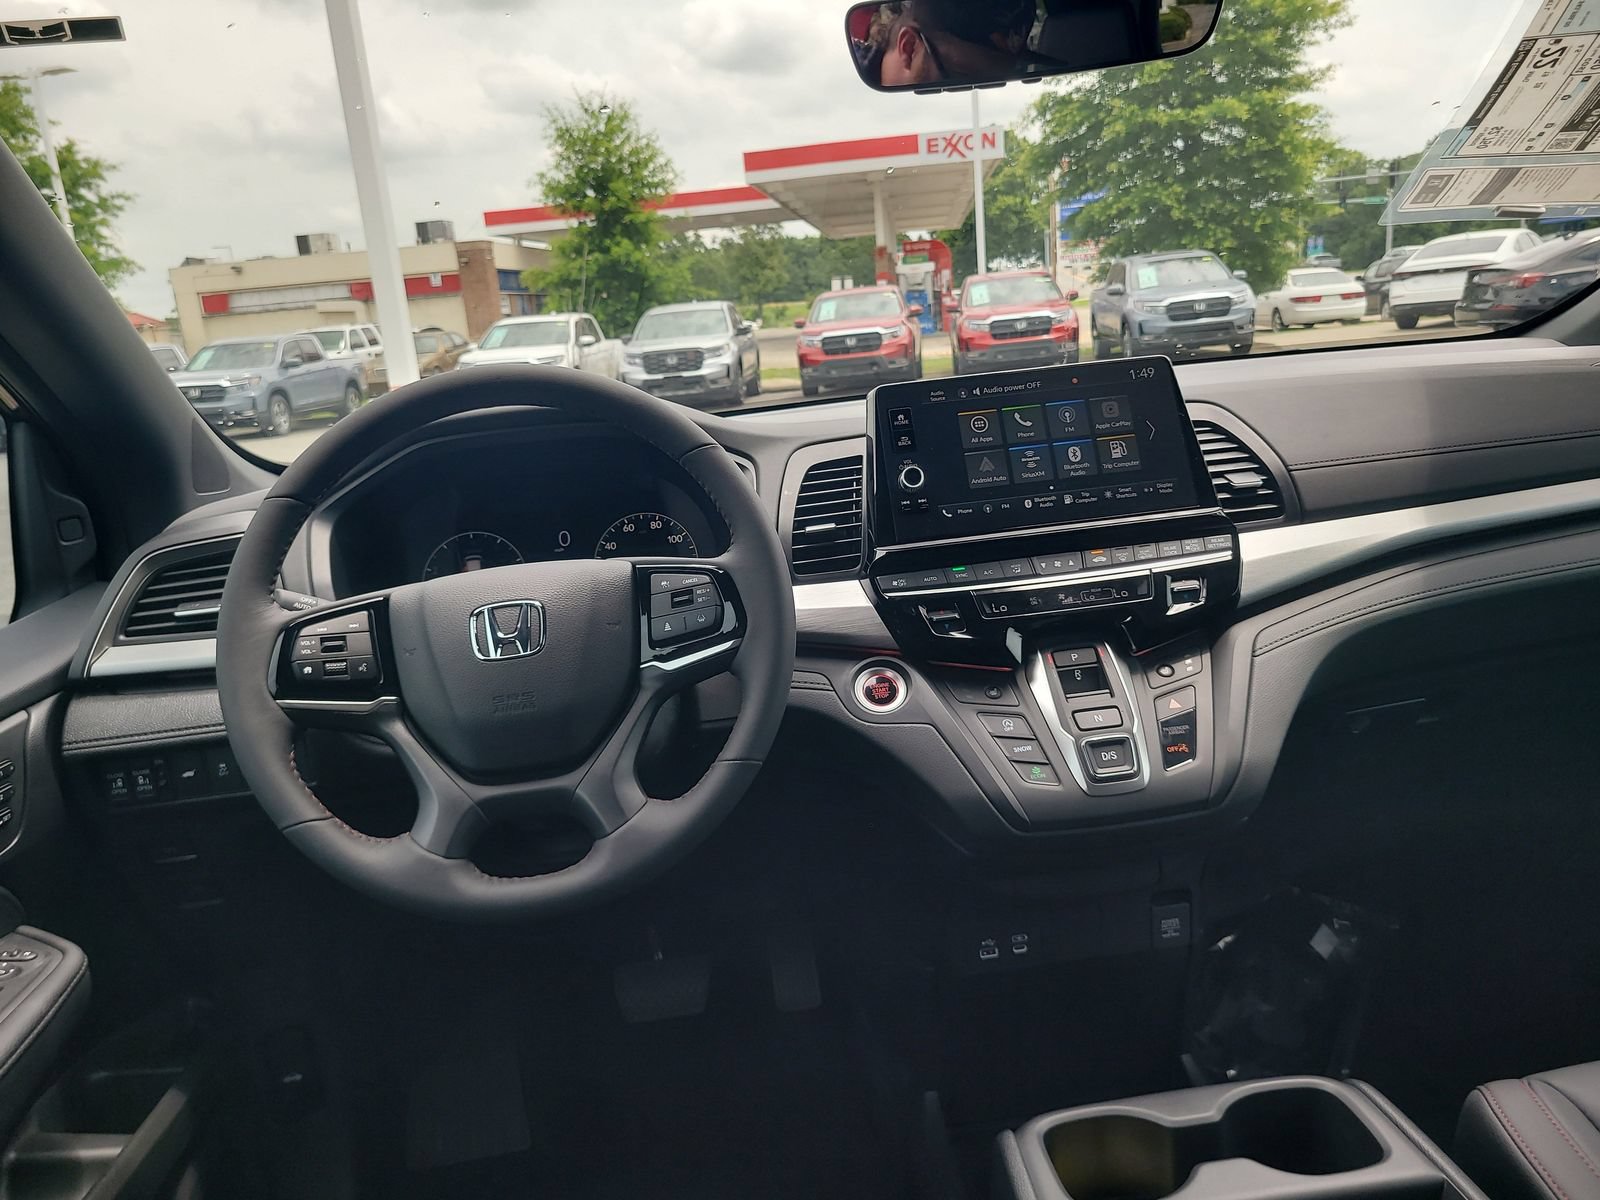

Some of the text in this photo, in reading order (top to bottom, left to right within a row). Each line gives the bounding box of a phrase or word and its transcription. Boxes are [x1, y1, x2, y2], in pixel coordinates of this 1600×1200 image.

[928, 132, 996, 158] EXXON
[1129, 367, 1154, 380] 1:49
[983, 386, 1002, 394] Audio
[1114, 460, 1139, 468] Computer
[623, 523, 635, 532] 60
[650, 520, 662, 529] 80
[558, 530, 570, 547] 0
[667, 534, 683, 544] 100
[604, 542, 617, 550] 40
[1113, 588, 1128, 598] Lo
[992, 603, 1008, 613] Lo
[1075, 670, 1082, 678] R
[1101, 751, 1117, 761] D/S
